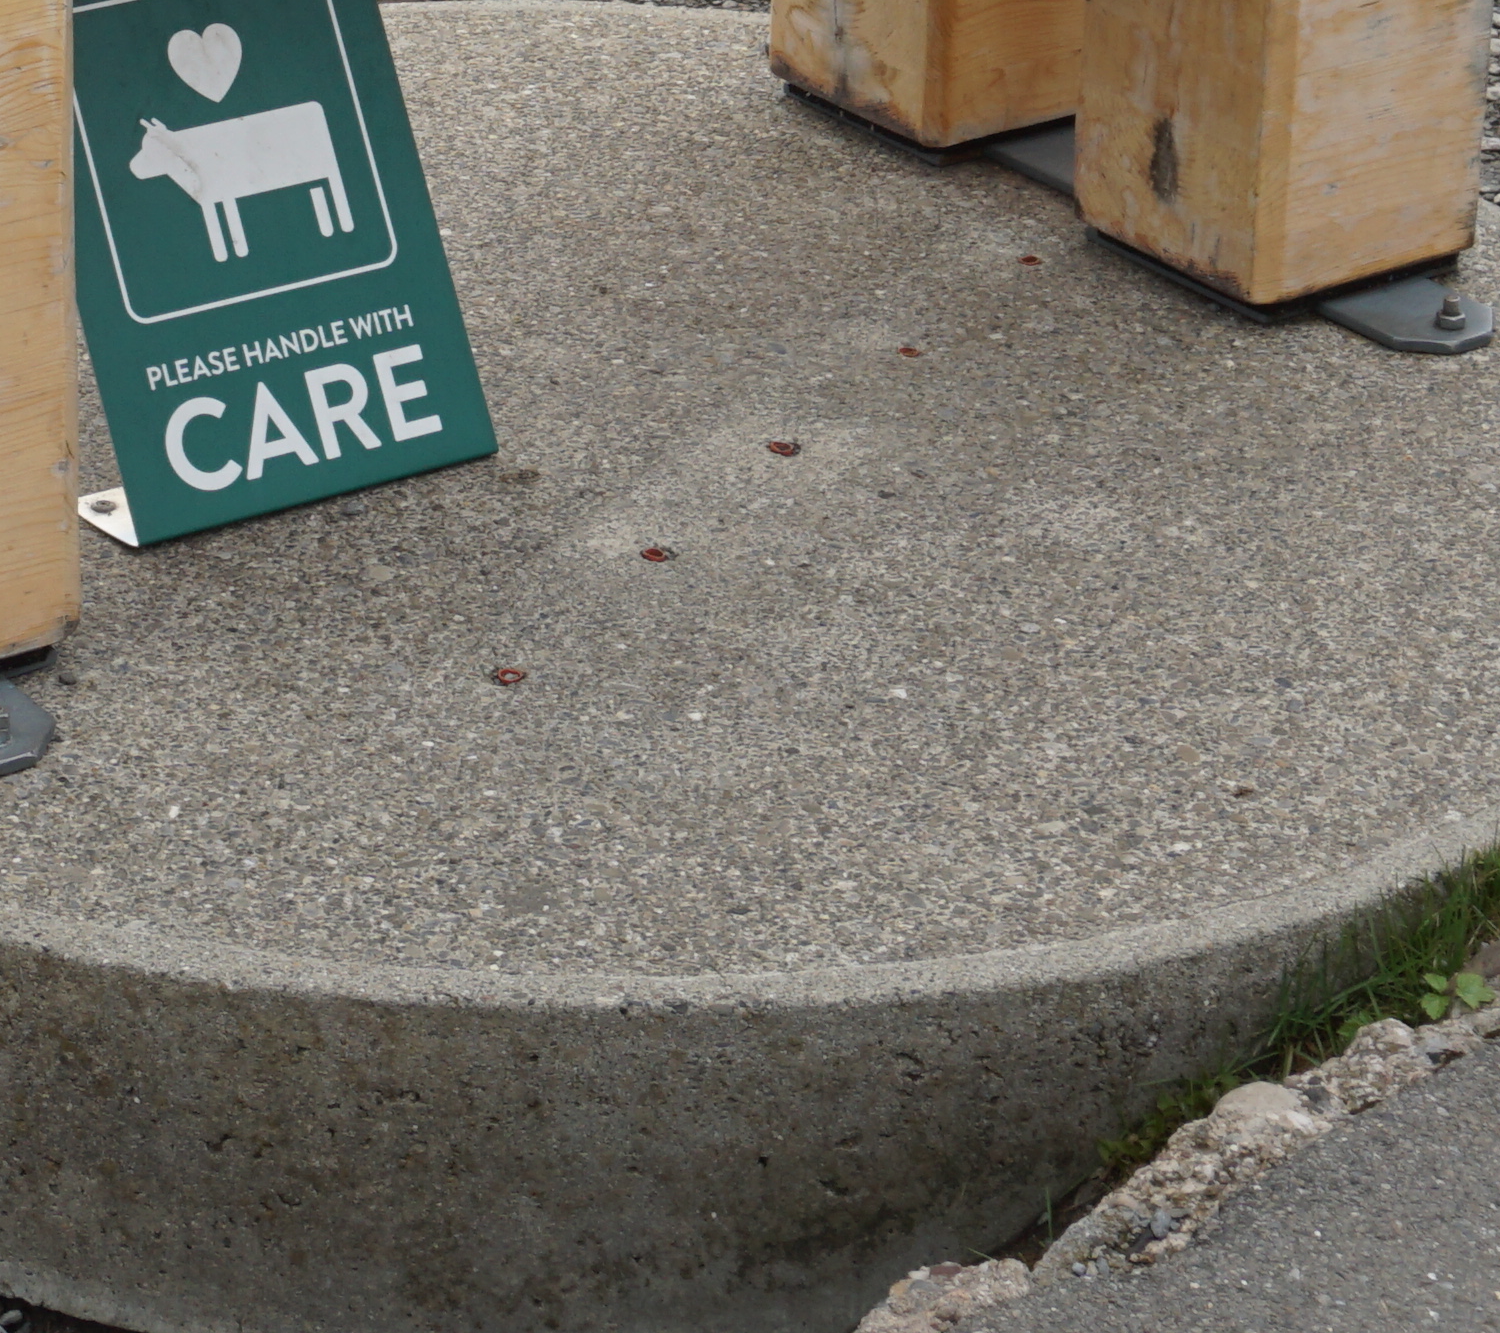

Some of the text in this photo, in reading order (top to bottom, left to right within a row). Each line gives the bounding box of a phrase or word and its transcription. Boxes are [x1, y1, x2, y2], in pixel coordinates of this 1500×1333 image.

[146, 304, 414, 391] PLEASE HANDLE WITH
[164, 343, 443, 491] CARE
